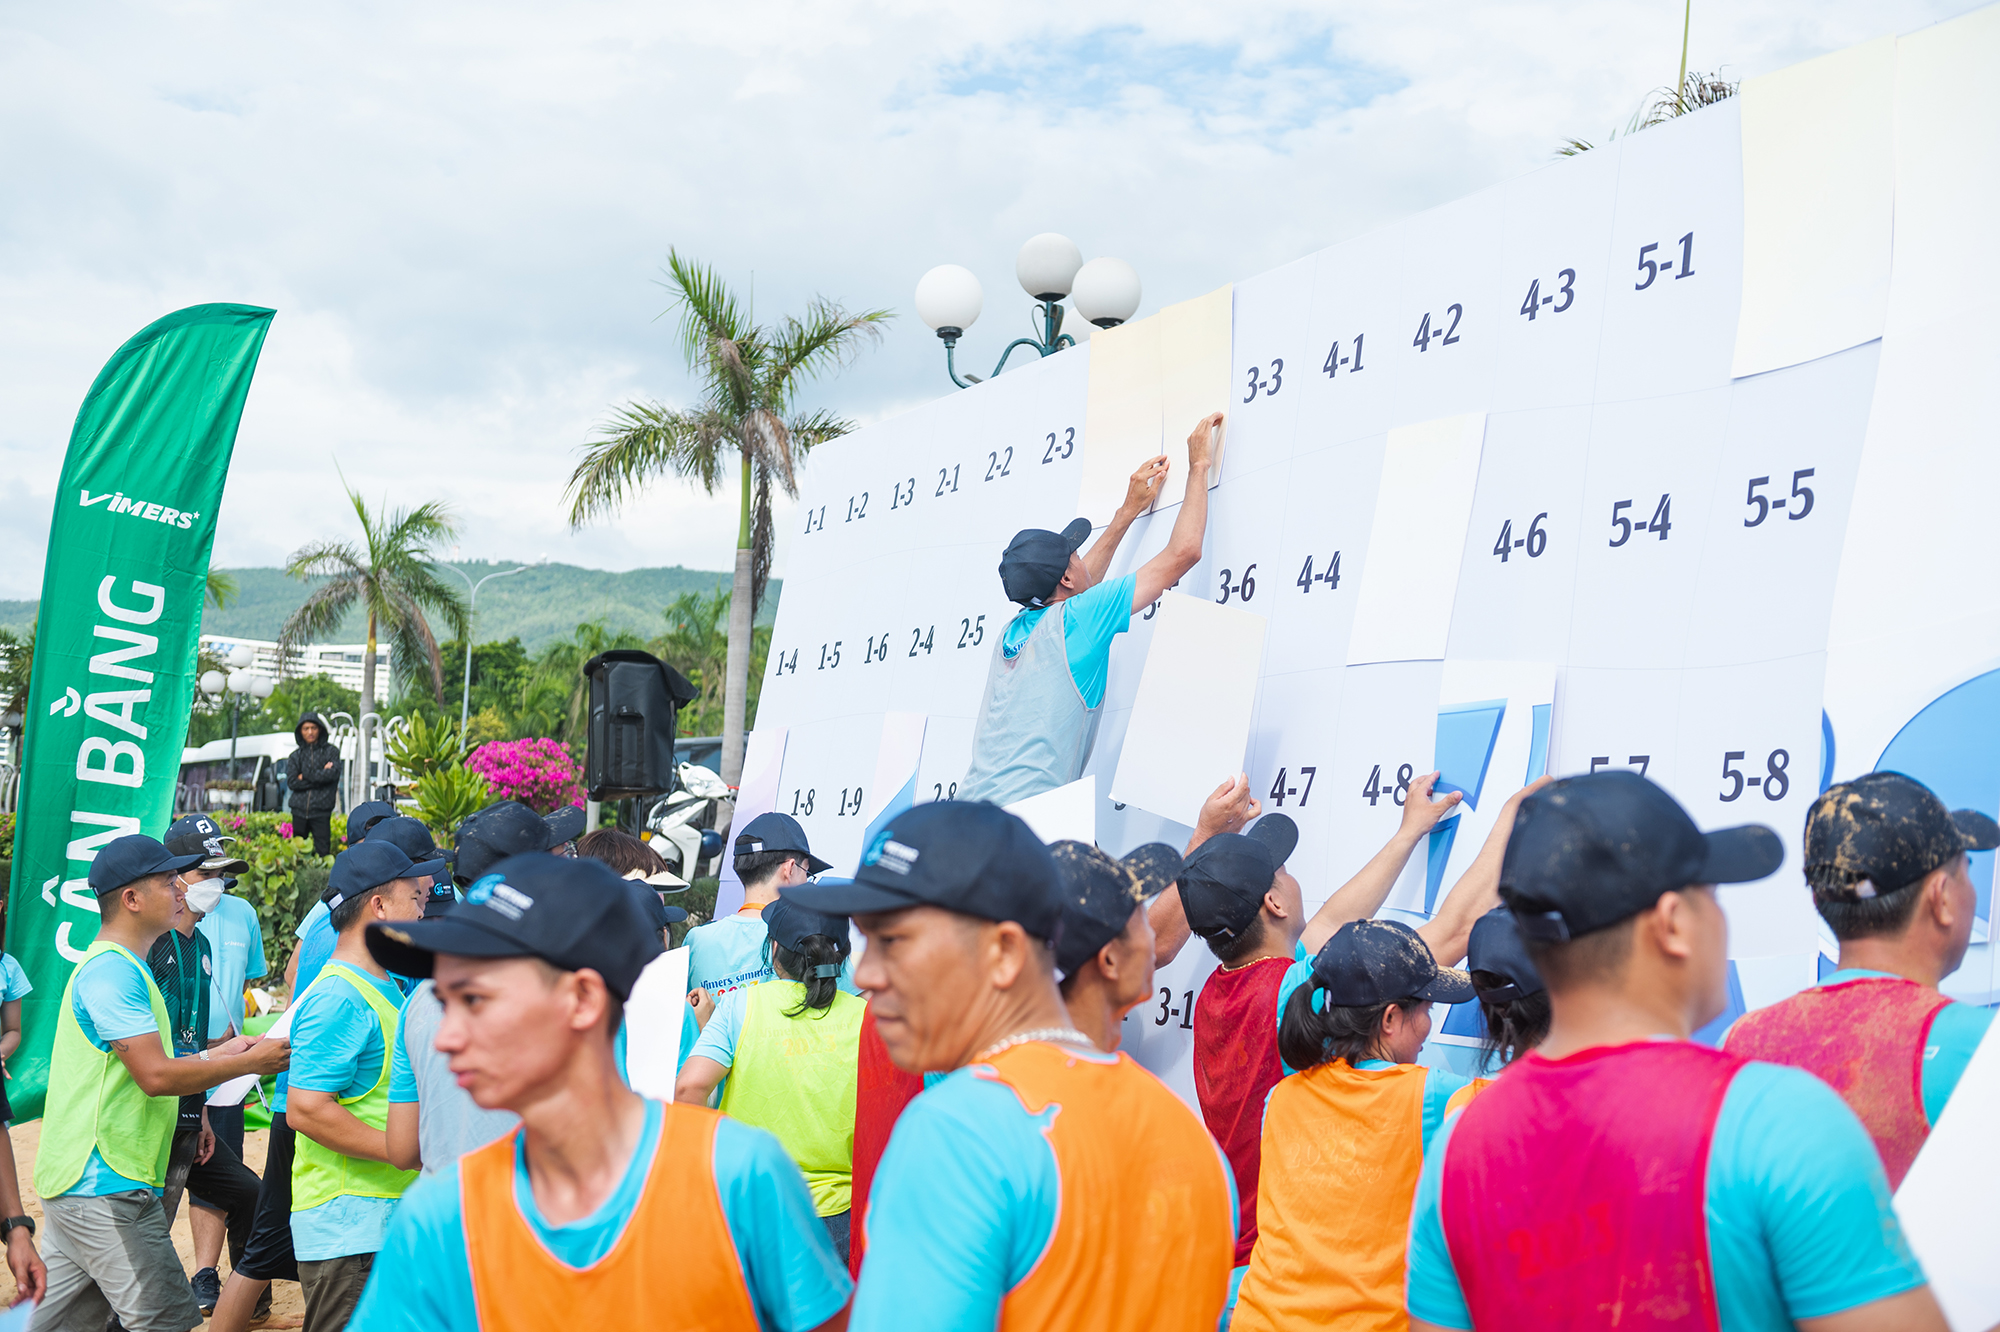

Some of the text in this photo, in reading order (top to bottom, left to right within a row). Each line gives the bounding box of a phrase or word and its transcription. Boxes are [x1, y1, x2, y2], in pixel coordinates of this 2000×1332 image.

[1634, 231, 1696, 291] 5-1
[1519, 267, 1576, 322] 4-3
[1412, 303, 1463, 353] 4-2
[1322, 333, 1365, 379] 4-1
[1243, 358, 1284, 404] 3-3
[984, 445, 1014, 483] 2-2
[1041, 426, 1076, 465] 2-3
[890, 477, 916, 511] 1-3
[934, 463, 961, 498] 2-1
[1743, 467, 1816, 528] 5-5
[803, 505, 826, 535] 1-1
[844, 491, 869, 523] 1-2
[1608, 493, 1672, 548] 5-4
[1492, 512, 1548, 563] 4-6
[1215, 563, 1257, 605] 3-6
[1296, 550, 1341, 594] 4-4
[863, 632, 890, 664] 1-6
[908, 625, 935, 658] 2-4
[956, 614, 986, 649] 2-5
[775, 648, 799, 677] 1-4
[817, 640, 843, 671] 1-5
[50, 574, 166, 788] BẰNG
[1269, 766, 1317, 807] 4-7
[1362, 763, 1413, 806] 4-8
[1719, 748, 1790, 803] 5-8
[790, 788, 816, 816] 1-8
[837, 787, 863, 816] 1-9
[735, 966, 774, 983] summer
